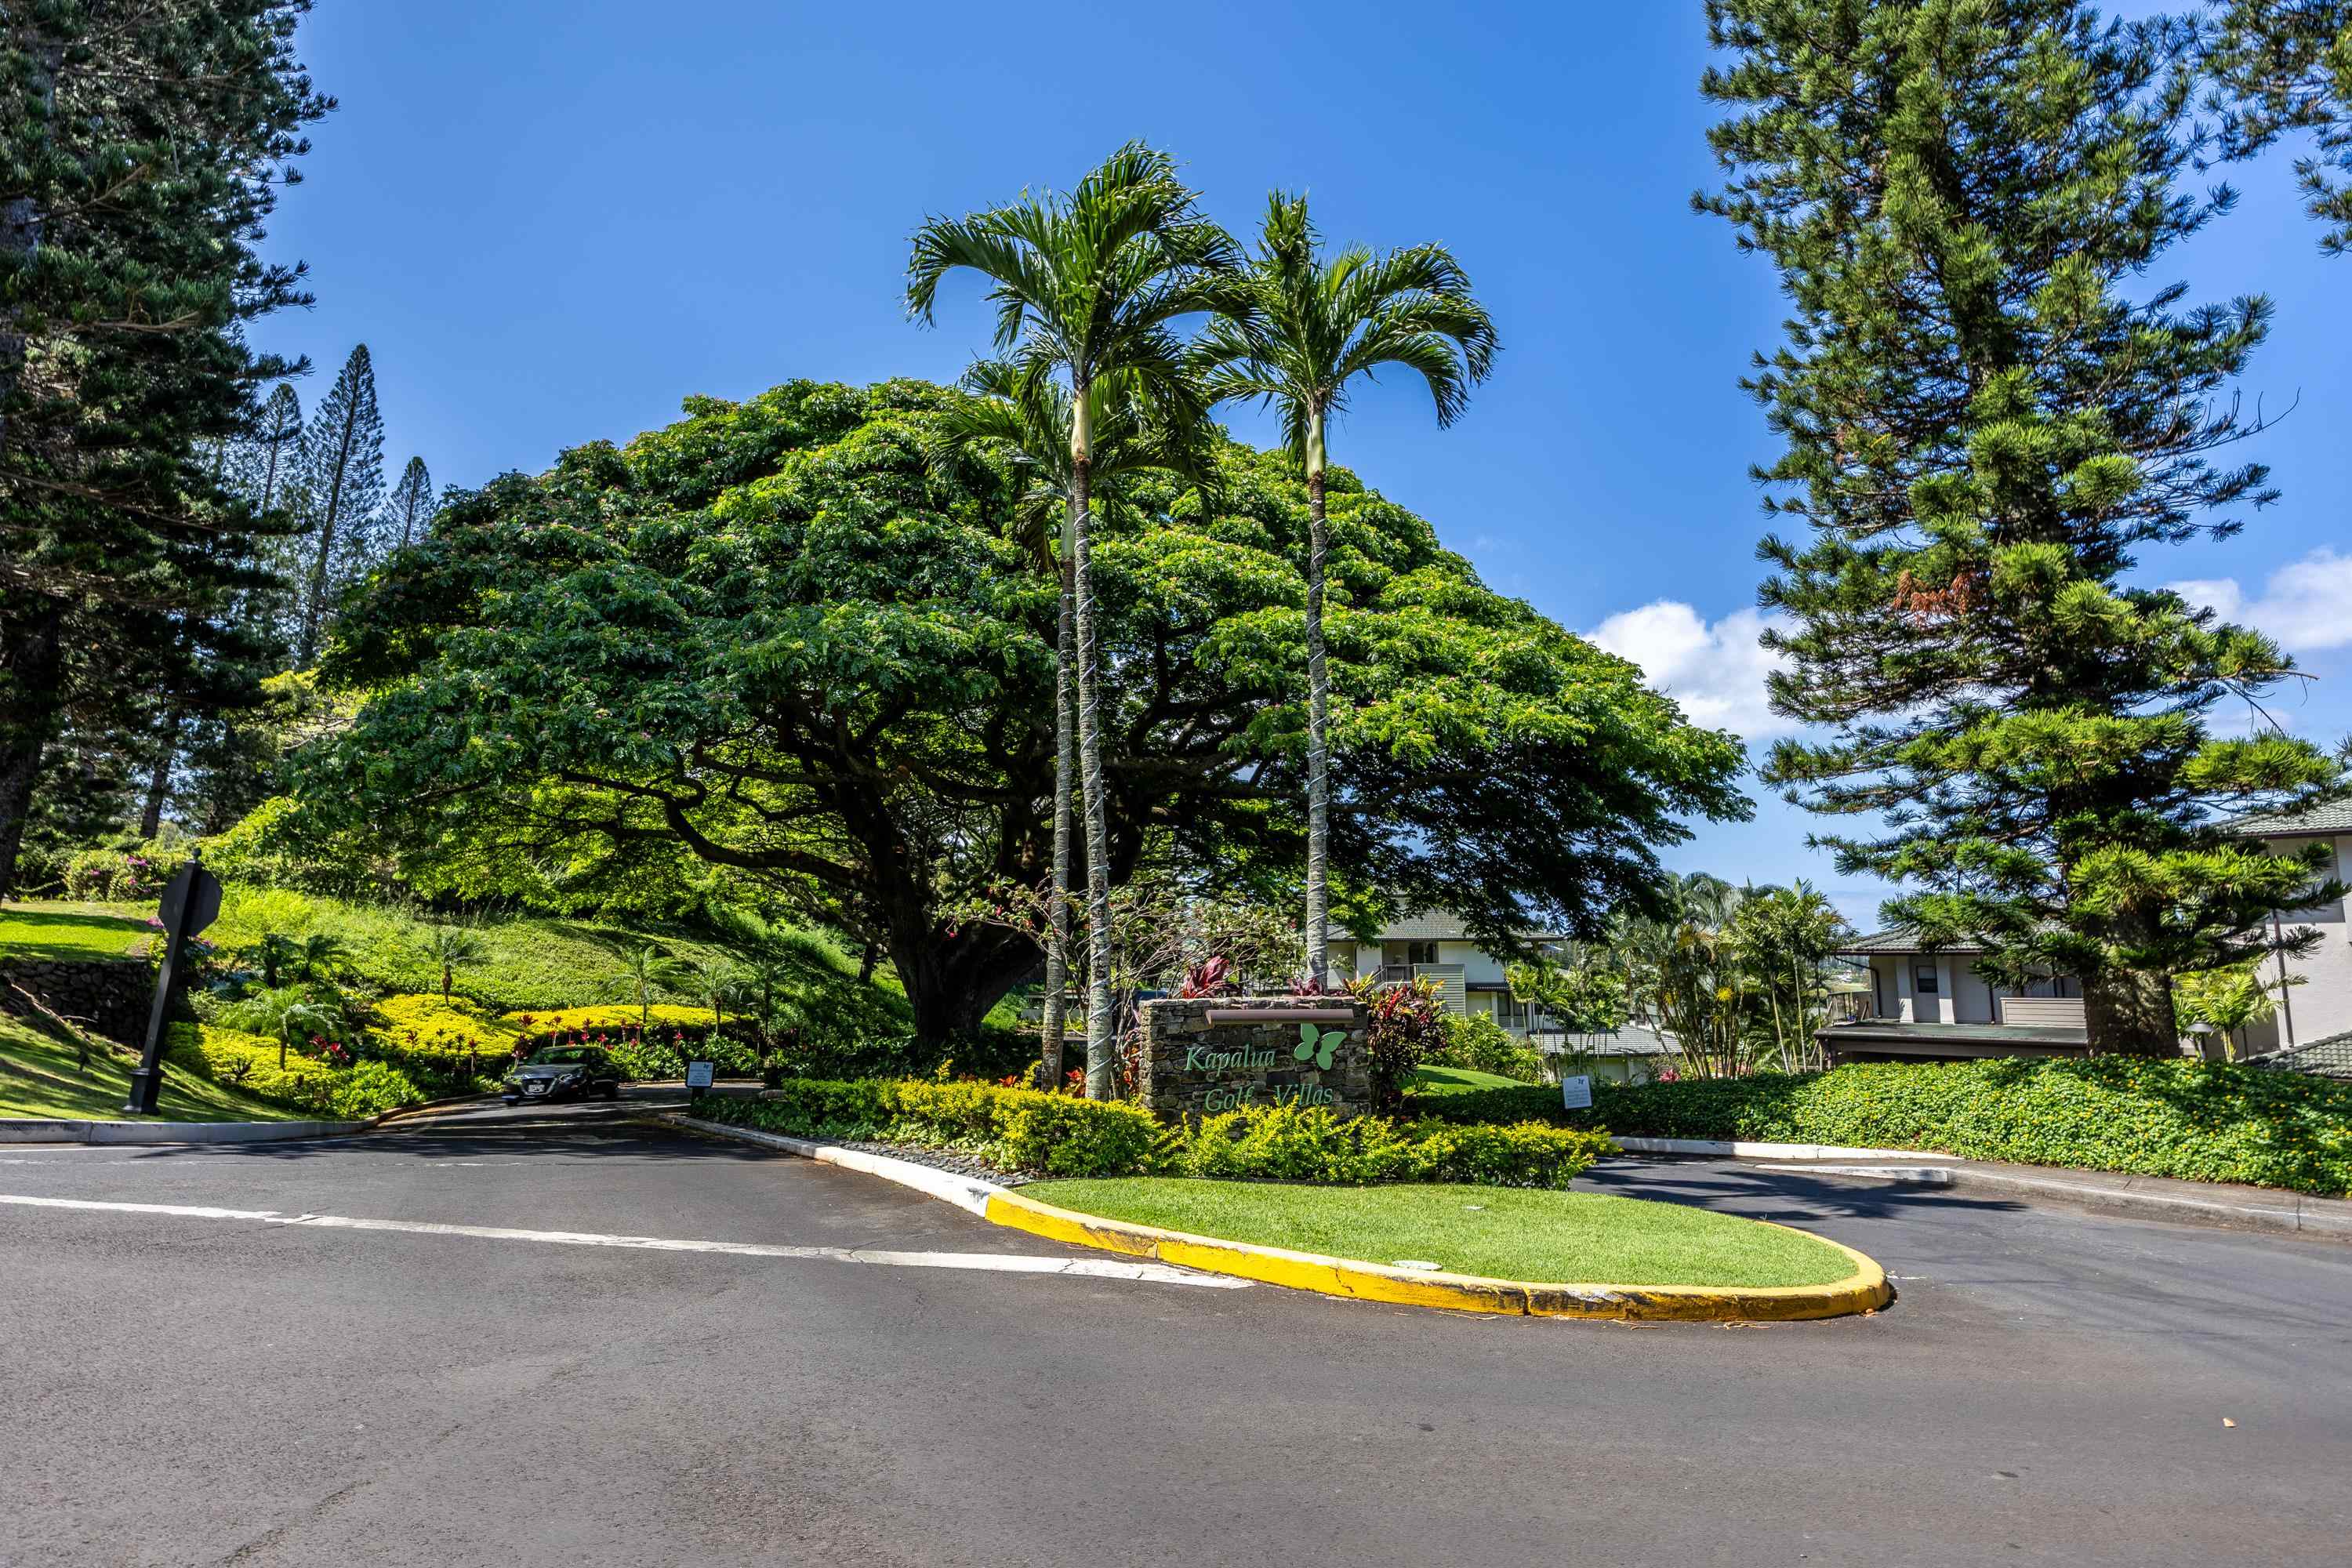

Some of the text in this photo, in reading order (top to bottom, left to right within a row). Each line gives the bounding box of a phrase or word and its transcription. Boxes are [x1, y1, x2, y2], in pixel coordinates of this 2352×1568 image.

[1184, 1044, 1276, 1077] Kapalua
[1205, 1083, 1334, 1112] Golf Vllas
